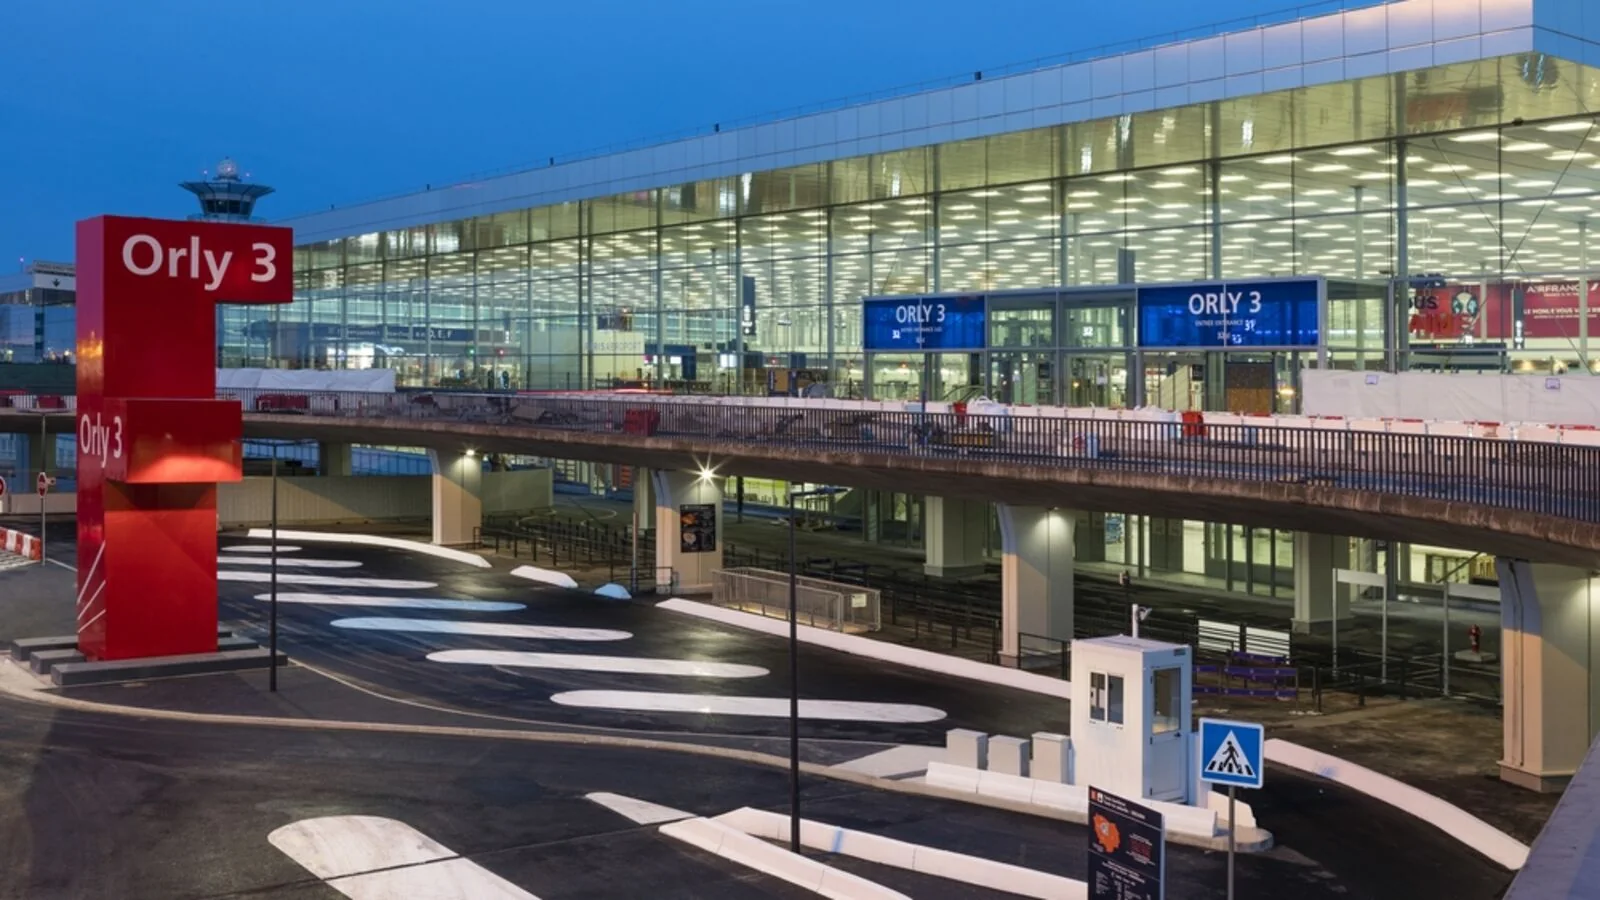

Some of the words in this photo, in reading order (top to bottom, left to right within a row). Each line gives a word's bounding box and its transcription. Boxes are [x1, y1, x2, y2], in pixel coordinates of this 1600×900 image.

[122, 233, 233, 292] Orly
[250, 242, 277, 283] 3
[896, 304, 933, 324] ORLY
[936, 303, 946, 323] 3
[1188, 292, 1243, 315] ORLY
[1249, 290, 1262, 313] 3
[80, 413, 110, 469] Orly
[113, 417, 122, 459] 3
